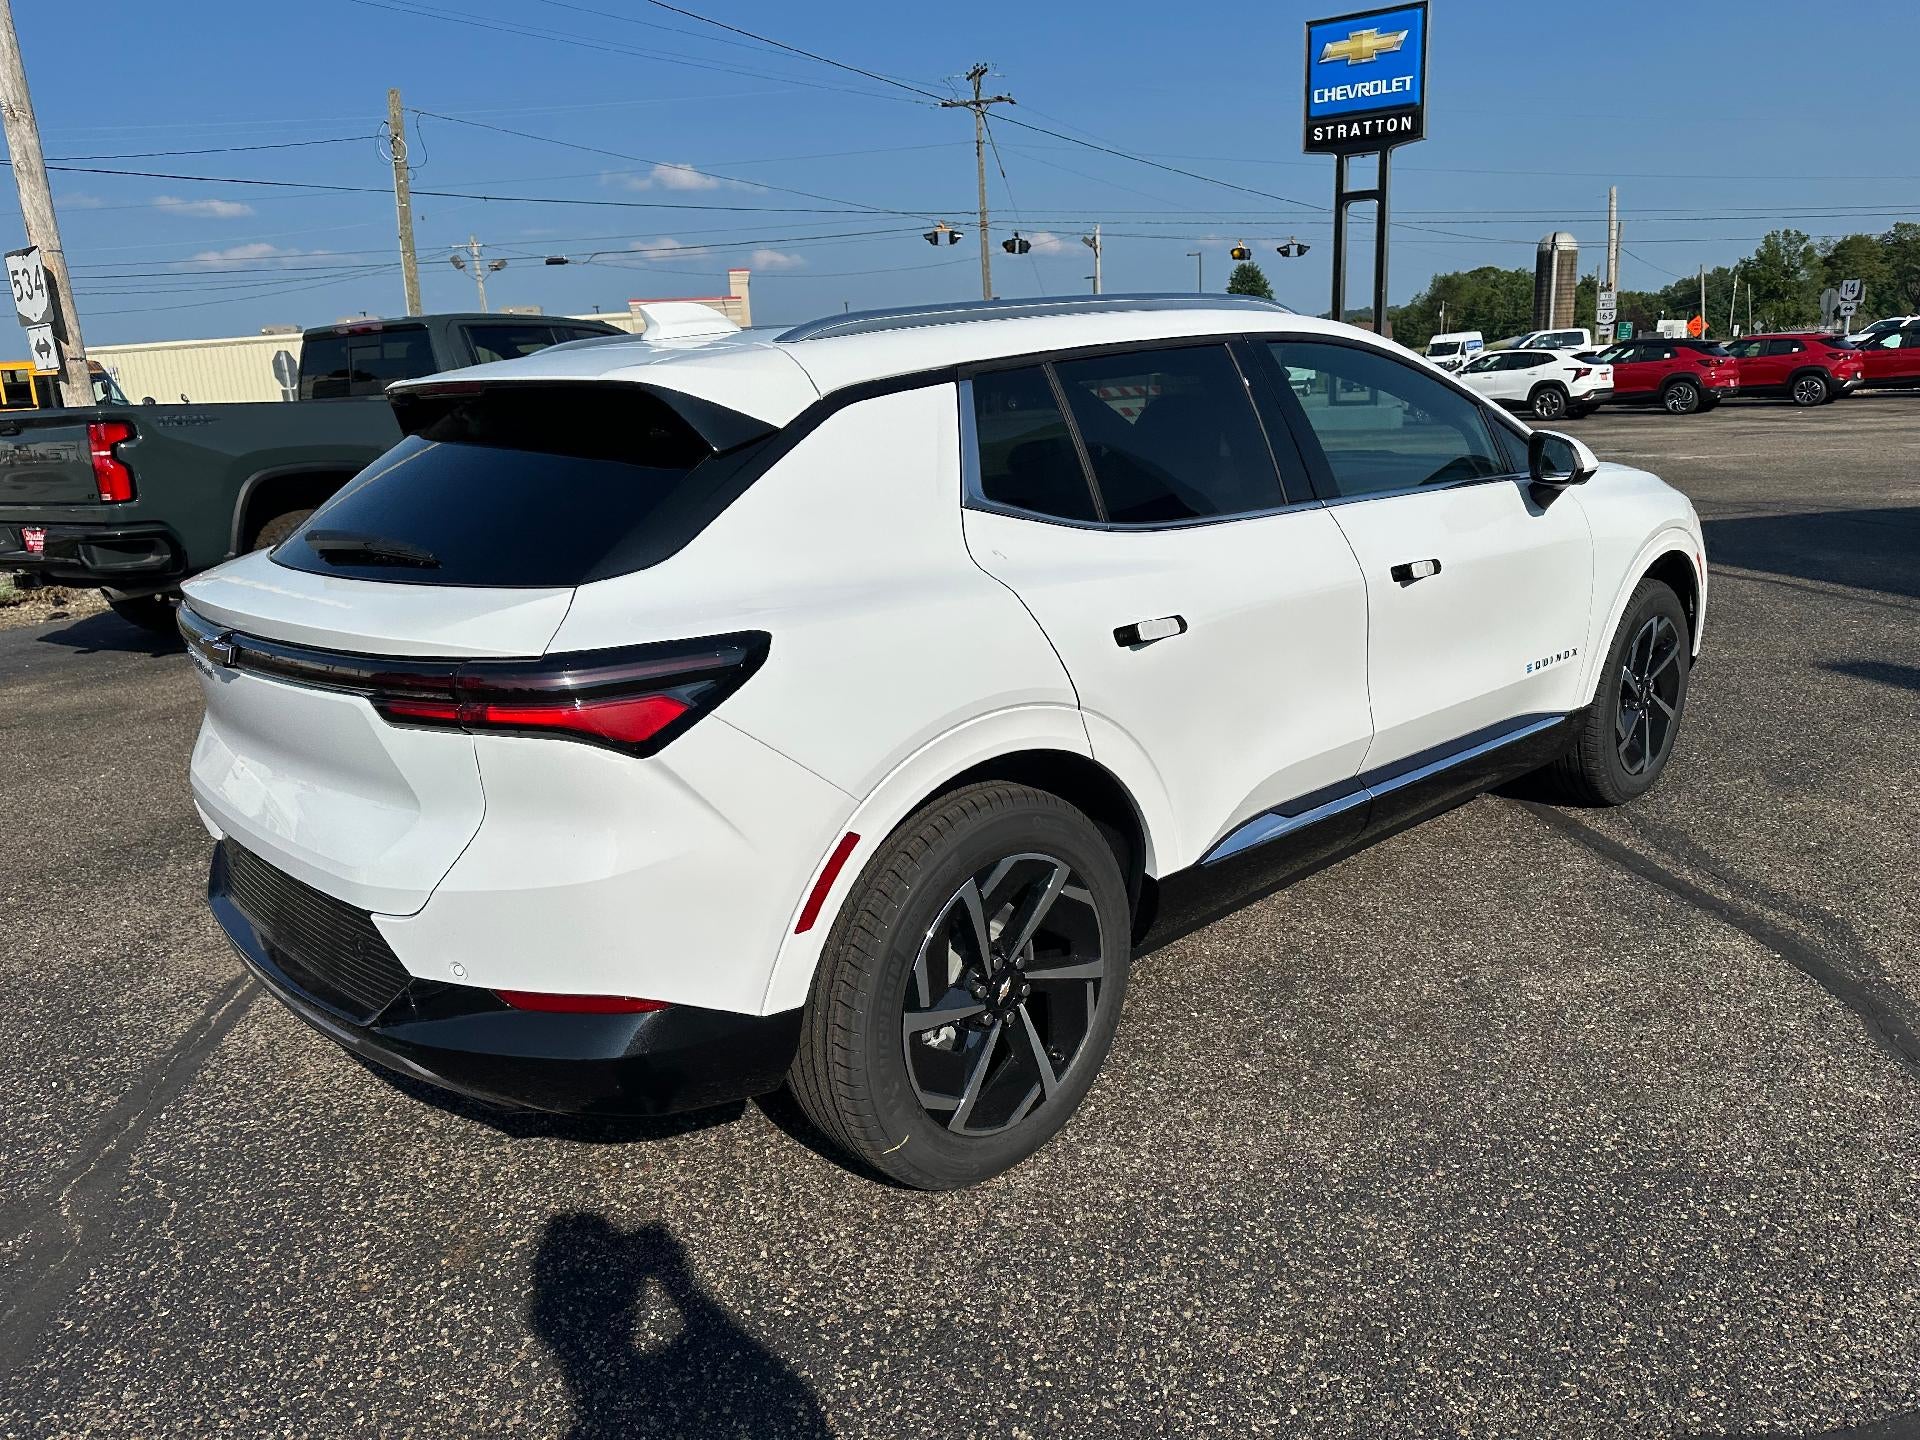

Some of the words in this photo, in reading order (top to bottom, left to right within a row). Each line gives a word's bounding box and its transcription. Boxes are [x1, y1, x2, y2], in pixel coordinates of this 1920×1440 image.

[1313, 75, 1414, 104] CHEVROLET
[1313, 116, 1412, 141] STRATTON
[11, 264, 45, 303] 534
[1845, 282, 1856, 296] 14
[1599, 311, 1614, 321] 165
[1526, 647, 1578, 674] EQUINOX
